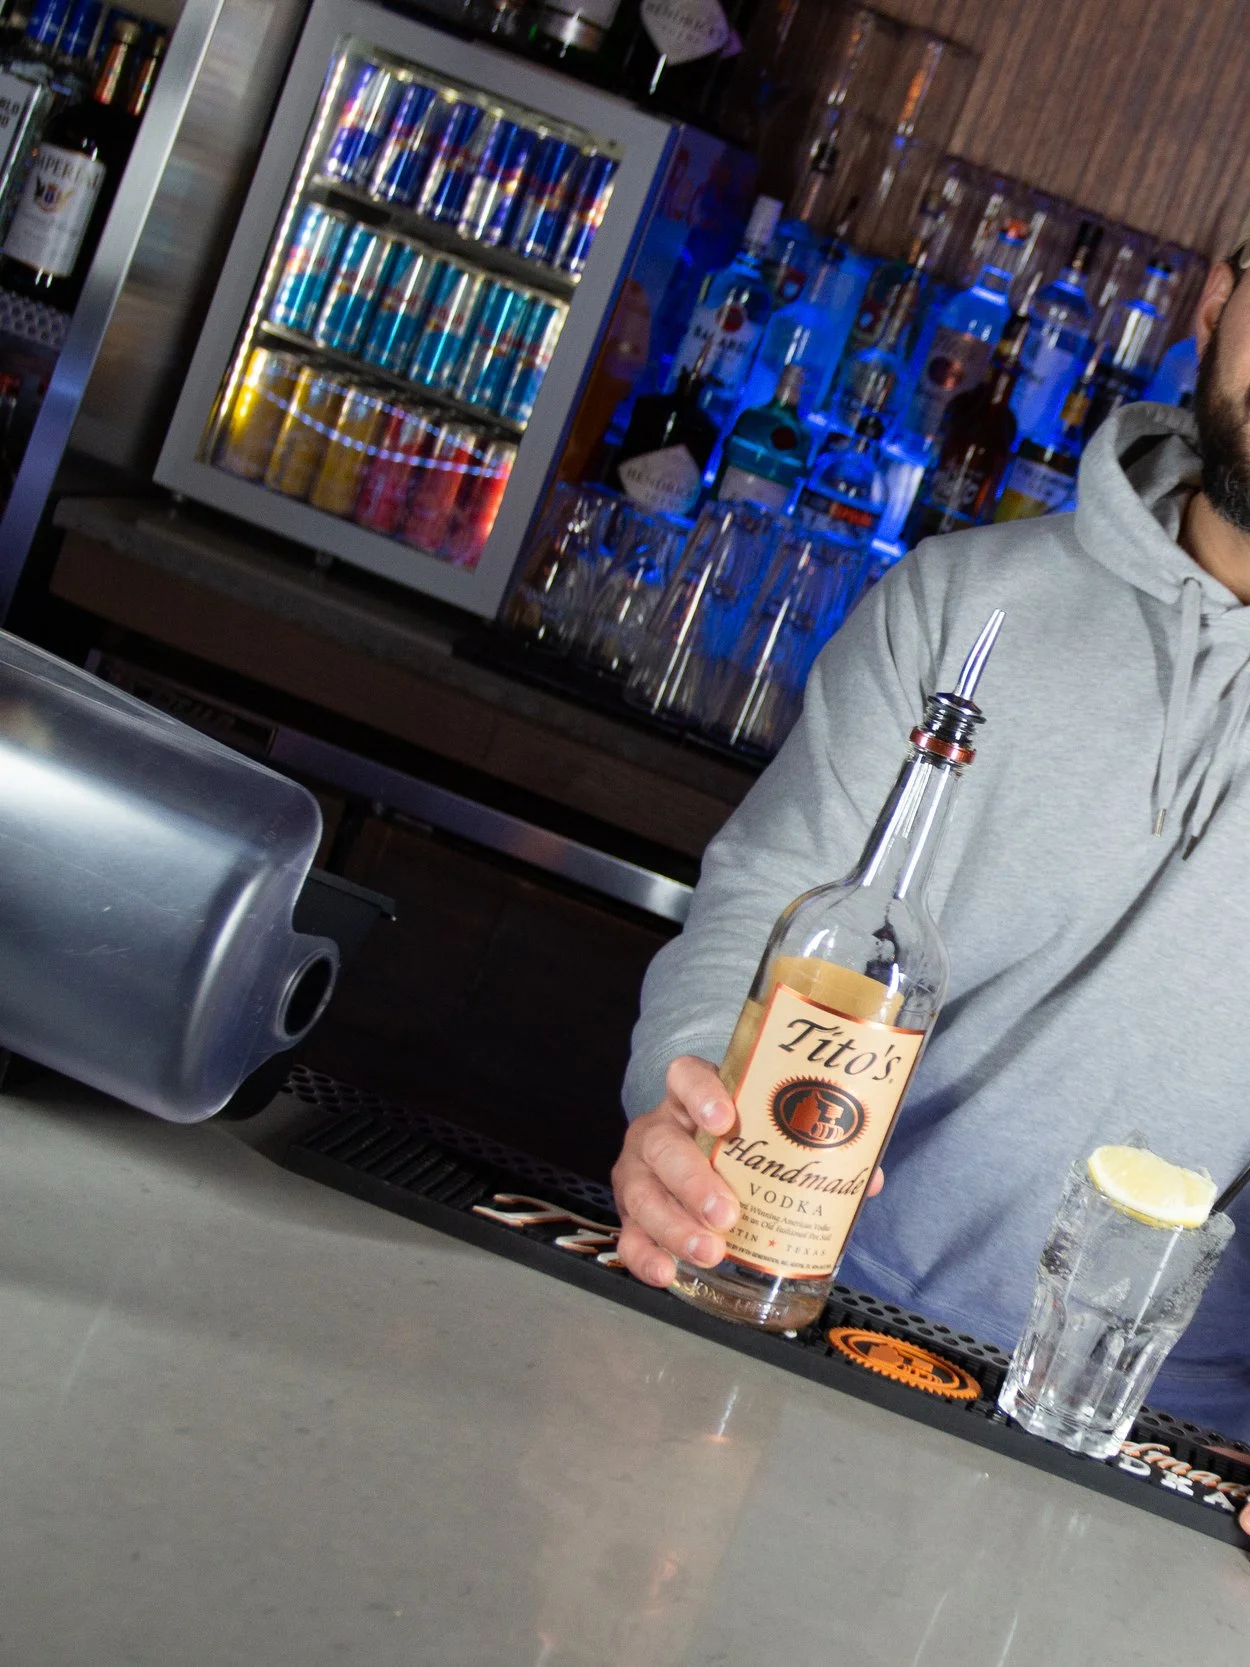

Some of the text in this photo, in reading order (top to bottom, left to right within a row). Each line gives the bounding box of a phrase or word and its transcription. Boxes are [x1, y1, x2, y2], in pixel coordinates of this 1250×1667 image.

[778, 1018, 902, 1081] Tito's
[723, 1136, 869, 1196] Handmade
[749, 1182, 823, 1217] VODKA
[729, 1226, 826, 1257] STIN TEXAS
[1119, 1452, 1236, 1513] DKA
